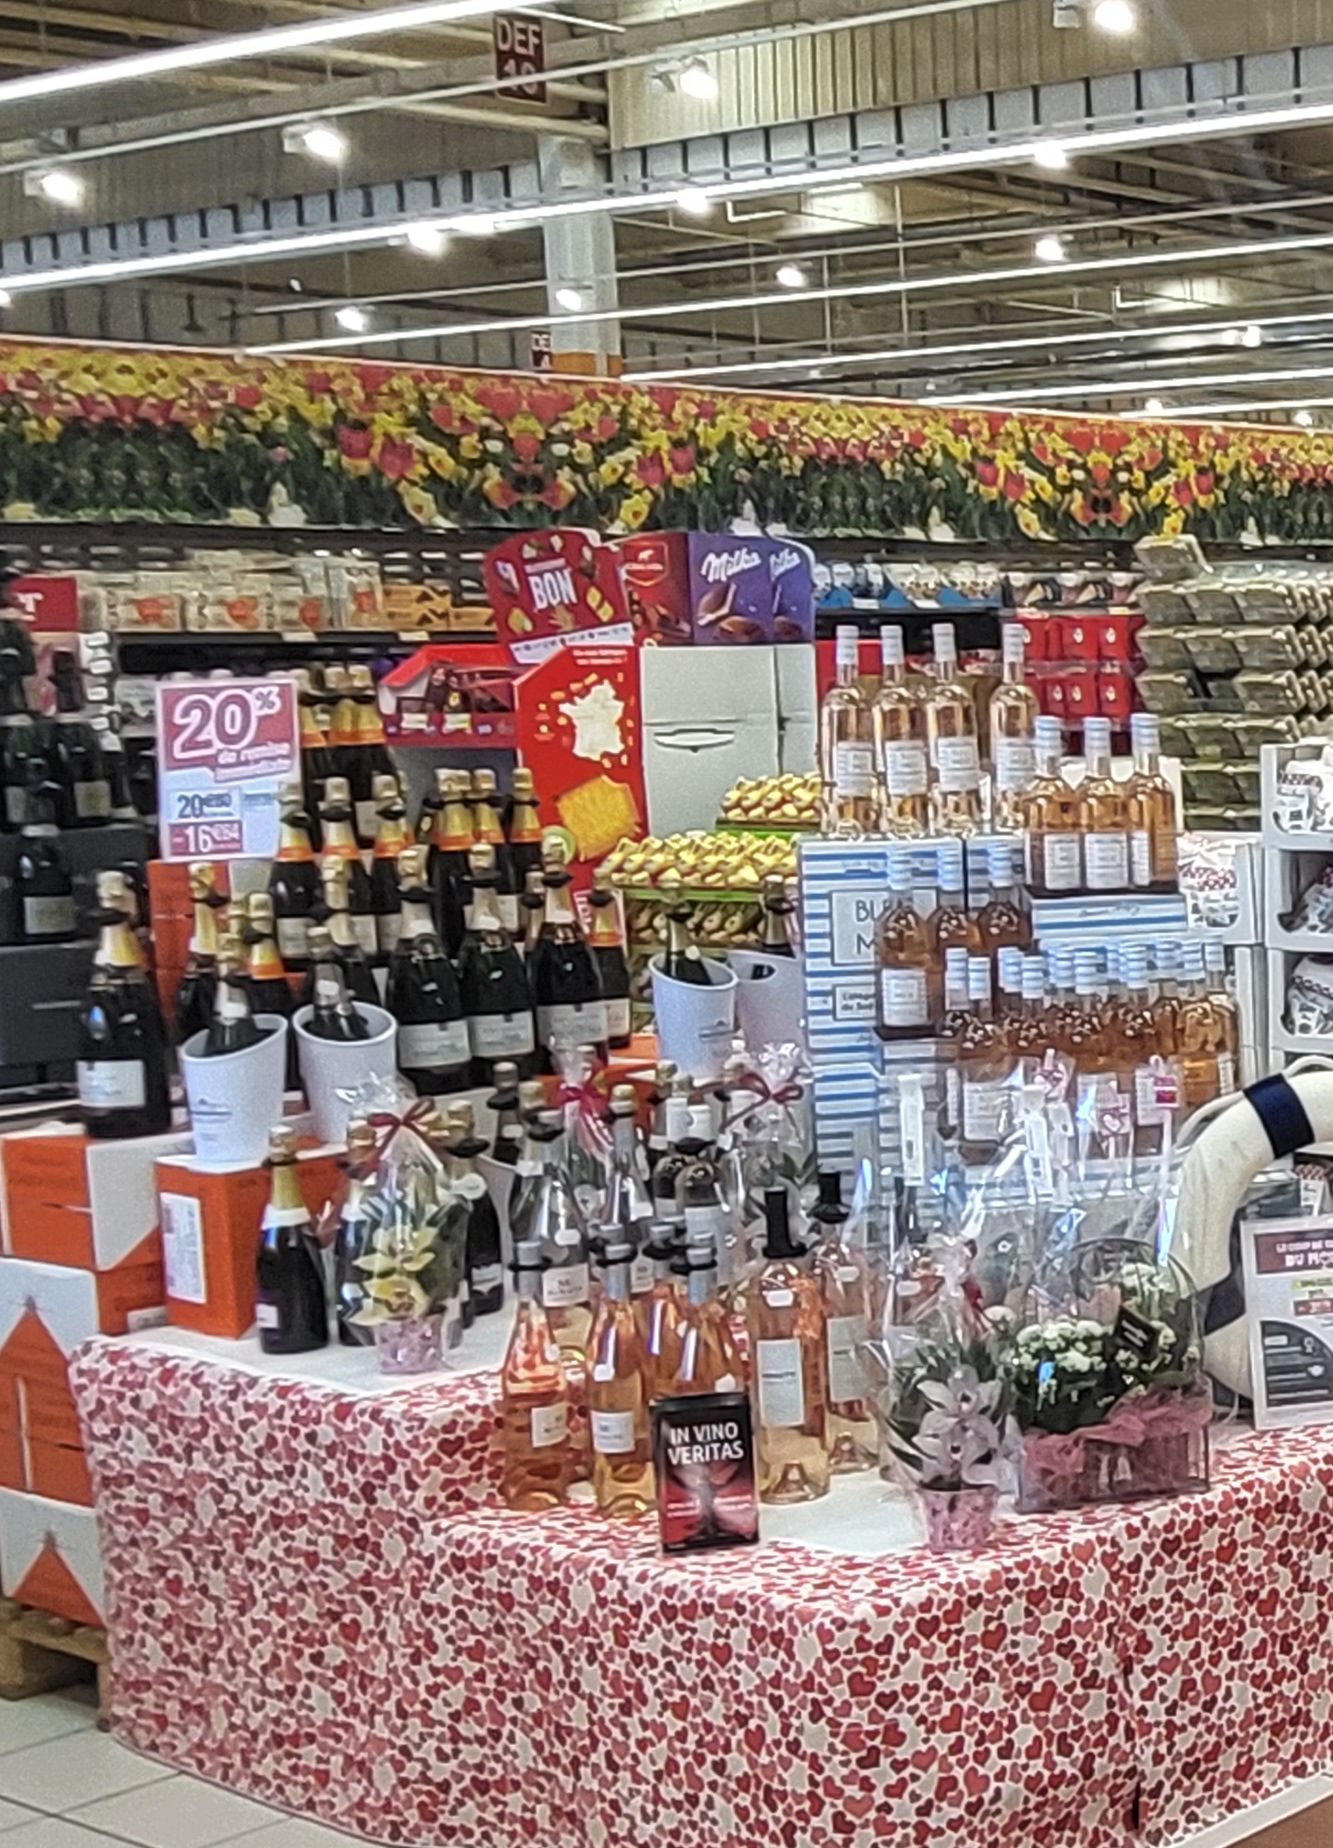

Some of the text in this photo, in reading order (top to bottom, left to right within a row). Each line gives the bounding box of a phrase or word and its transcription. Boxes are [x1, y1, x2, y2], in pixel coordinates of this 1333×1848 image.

[497, 17, 541, 56] DEF
[701, 547, 761, 583] Milka
[529, 568, 578, 611] BON
[173, 685, 282, 760] 20%
[670, 1422, 739, 1445] IN VINO
[667, 1441, 745, 1466] VERITAS
